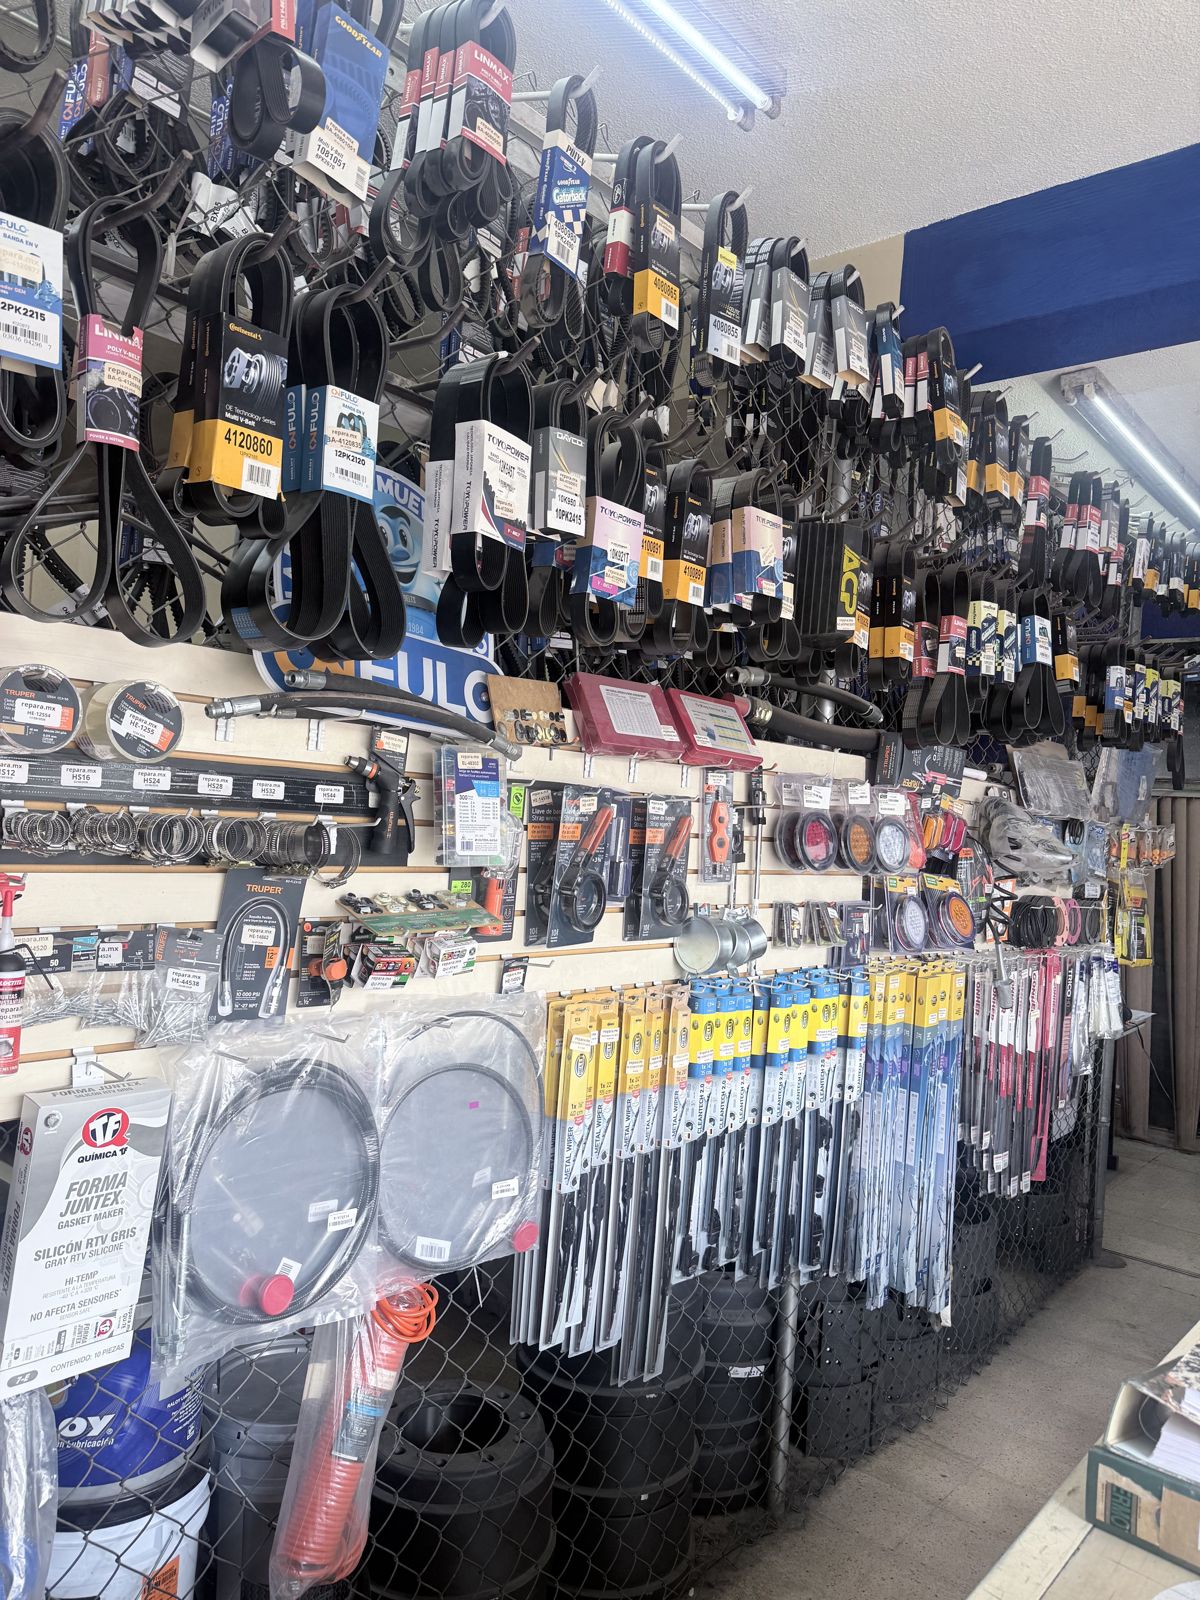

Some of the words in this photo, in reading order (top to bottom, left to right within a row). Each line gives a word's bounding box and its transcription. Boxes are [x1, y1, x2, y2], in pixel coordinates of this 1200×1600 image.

[335, 15, 383, 58] GOODYEAR
[473, 49, 510, 85] LINMAX
[316, 145, 347, 171] 1081051
[552, 186, 588, 206] Gatorback
[3, 233, 25, 245] BANDA
[25, 239, 34, 247] EN
[0, 301, 46, 322] 2PK2215
[229, 322, 258, 341] Continental
[712, 319, 739, 339] 4080855
[107, 344, 122, 354] POLY
[122, 349, 141, 361] V-BELT
[331, 388, 358, 403] ONFULO
[225, 404, 234, 413] OE
[234, 407, 261, 423] Technology
[261, 415, 277, 427] Series
[287, 391, 296, 450] ONFULO
[309, 391, 321, 450] ONFULO
[225, 428, 273, 457] 4120860
[332, 431, 358, 441] repara.mx
[556, 431, 585, 448] DAYCO
[487, 433, 530, 463] TOYOPOWER
[335, 450, 366, 467] 12PK2120
[462, 480, 472, 531] TOYOPOWER
[555, 508, 582, 526] 10PK2415
[599, 505, 642, 527] TOYOPOWER
[5, 688, 36, 699] TRUPER
[125, 692, 148, 711] TRUPER
[21, 701, 56, 713] repara.mx
[27, 710, 52, 719] HE-12554
[129, 711, 158, 731] repara.mx
[0, 763, 23, 773] ara.mx
[0, 769, 16, 779] S12
[66, 767, 97, 777] repara.mx
[138, 771, 167, 781] repara.mx
[72, 774, 91, 784] HS16
[143, 778, 161, 788] HS24
[202, 776, 230, 787] repara.mx
[207, 783, 224, 793] HS28
[256, 782, 281, 792] repara.mx
[261, 788, 277, 797] HS32
[322, 792, 337, 801] HS44
[246, 883, 283, 894] TRUPER
[461, 881, 472, 889] 280
[157, 929, 169, 956] TRUPER
[49, 958, 59, 967] 50
[172, 971, 201, 983] repara.mx
[172, 978, 200, 988] HE-44538
[51, 1087, 95, 1099] FORMA
[97, 1080, 143, 1092] JUNTEX
[77, 1149, 118, 1164] QUÍMICA
[65, 1171, 128, 1200] FORMA
[59, 1190, 122, 1218] JUNTEX
[8, 1201, 21, 1245] FORMA
[57, 1214, 92, 1231] GASKET
[93, 1207, 124, 1221] MAKER
[33, 1239, 83, 1263] SILICÓN
[85, 1233, 109, 1251] RTV
[110, 1226, 137, 1243] GRIS
[44, 1256, 69, 1270] GRAY
[69, 1250, 88, 1264] RTV
[88, 1242, 125, 1260] SILICONE
[2, 1249, 15, 1296] JUNTEX
[64, 1270, 99, 1287] HI-TEMP
[30, 1311, 43, 1323] NO
[44, 1303, 76, 1319] AFECTA
[50, 1356, 92, 1373] CONTENIDO:
[94, 1351, 102, 1360] 10
[103, 1343, 126, 1357] PIEZAS
